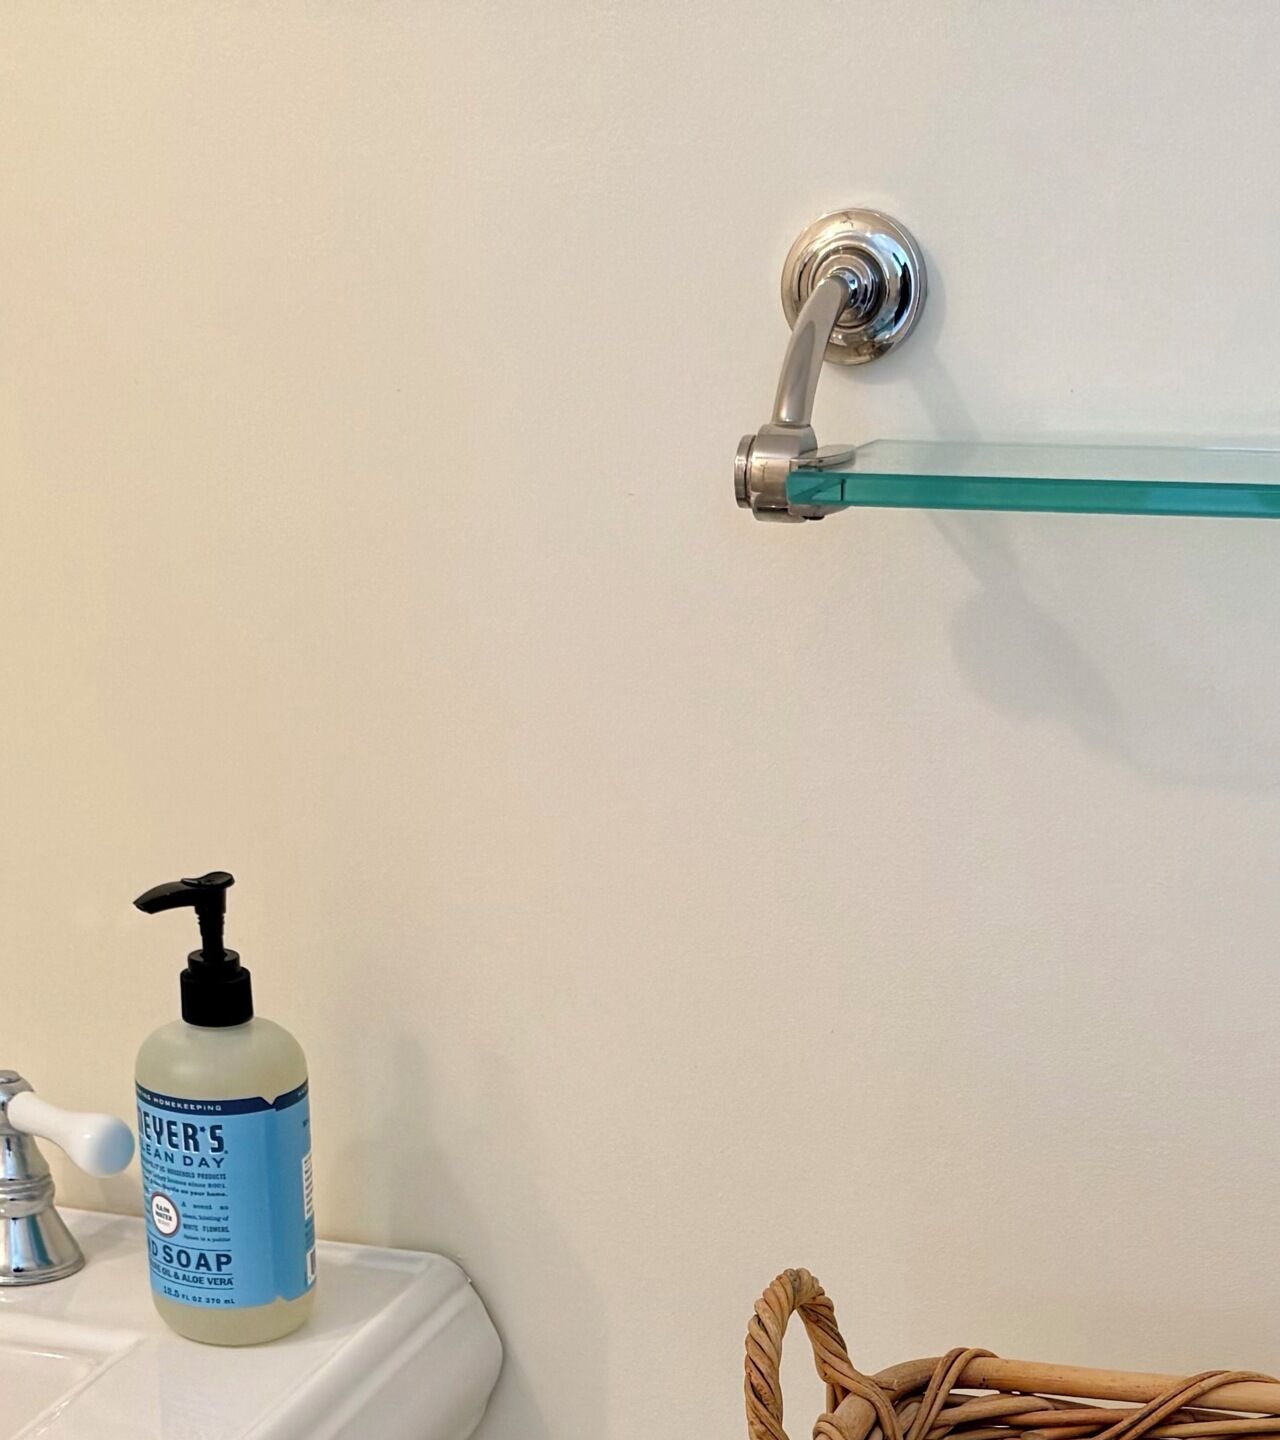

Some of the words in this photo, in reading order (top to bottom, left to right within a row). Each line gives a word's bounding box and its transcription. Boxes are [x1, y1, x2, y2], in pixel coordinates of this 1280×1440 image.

[153, 1097, 222, 1112] HOMEKEEPING
[141, 1143, 174, 1164] LEAN
[183, 1155, 225, 1168] DAY
[162, 1244, 232, 1272] SOAP
[173, 1271, 180, 1280] &
[181, 1274, 205, 1285] ALOE
[206, 1277, 234, 1286] VERA
[181, 1293, 190, 1301] FL
